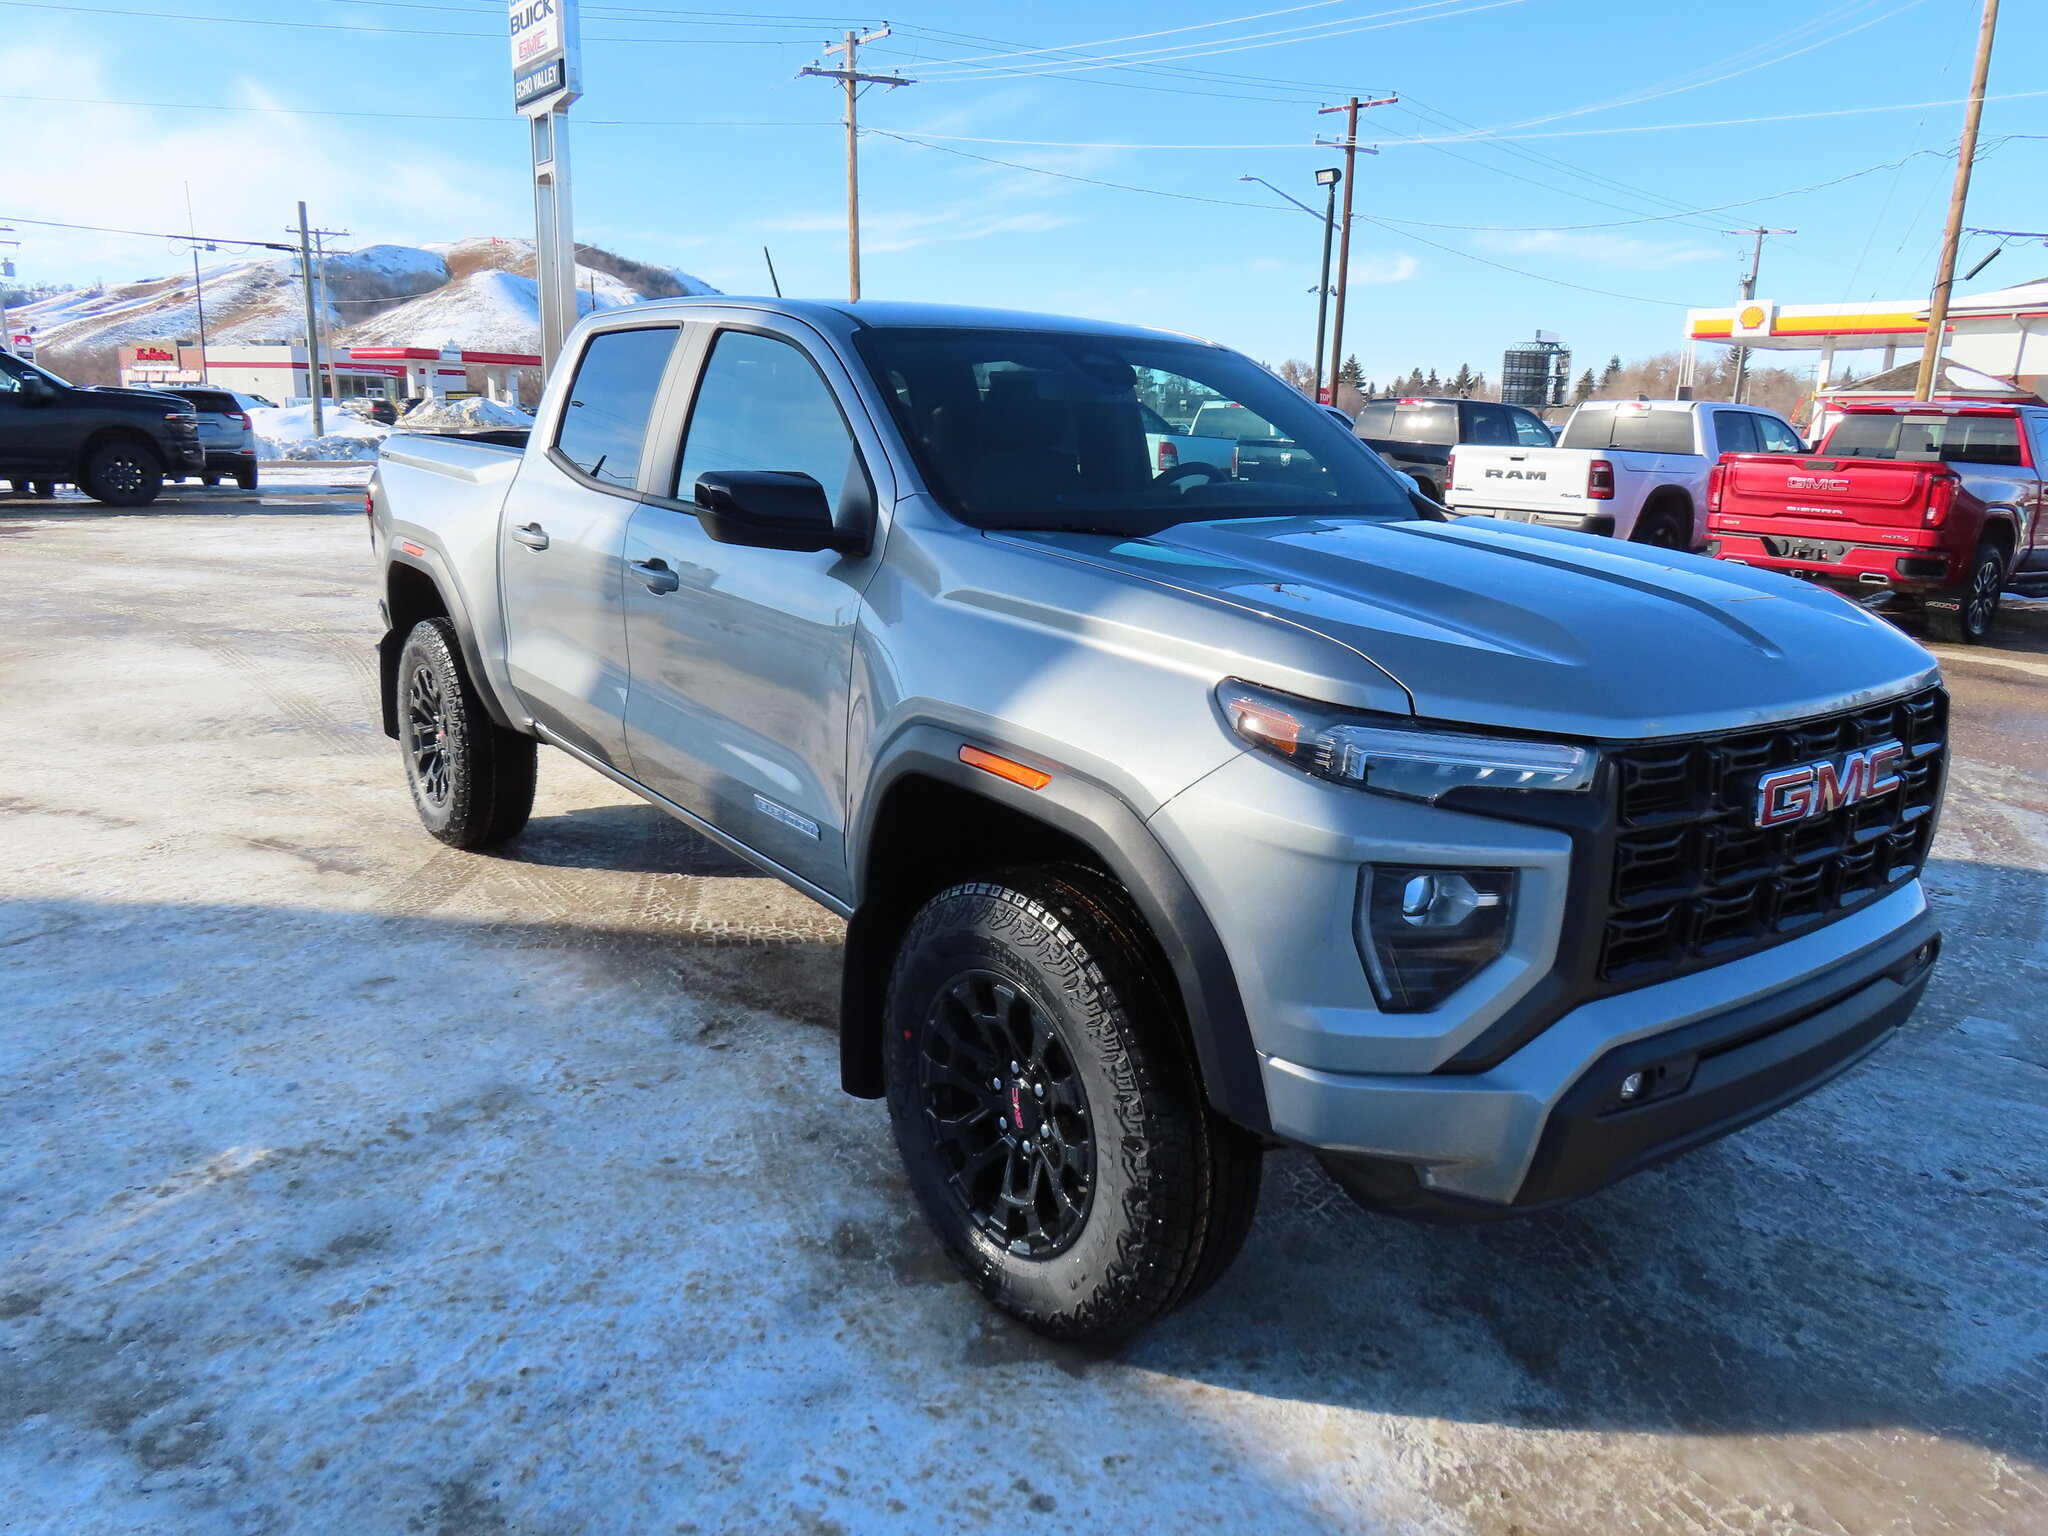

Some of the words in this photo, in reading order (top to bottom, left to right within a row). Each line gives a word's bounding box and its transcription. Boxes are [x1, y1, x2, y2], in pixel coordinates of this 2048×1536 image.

[511, 0, 554, 36] BUICK
[519, 28, 547, 59] GMC
[516, 78, 532, 99] ECHO
[533, 65, 557, 90] VALLEY
[1485, 469, 1547, 481] RAM
[1787, 476, 1850, 491] GMC
[1785, 506, 1843, 515] SIERRA
[1755, 739, 1904, 828] GMC
[1011, 1087, 1024, 1129] GMC
